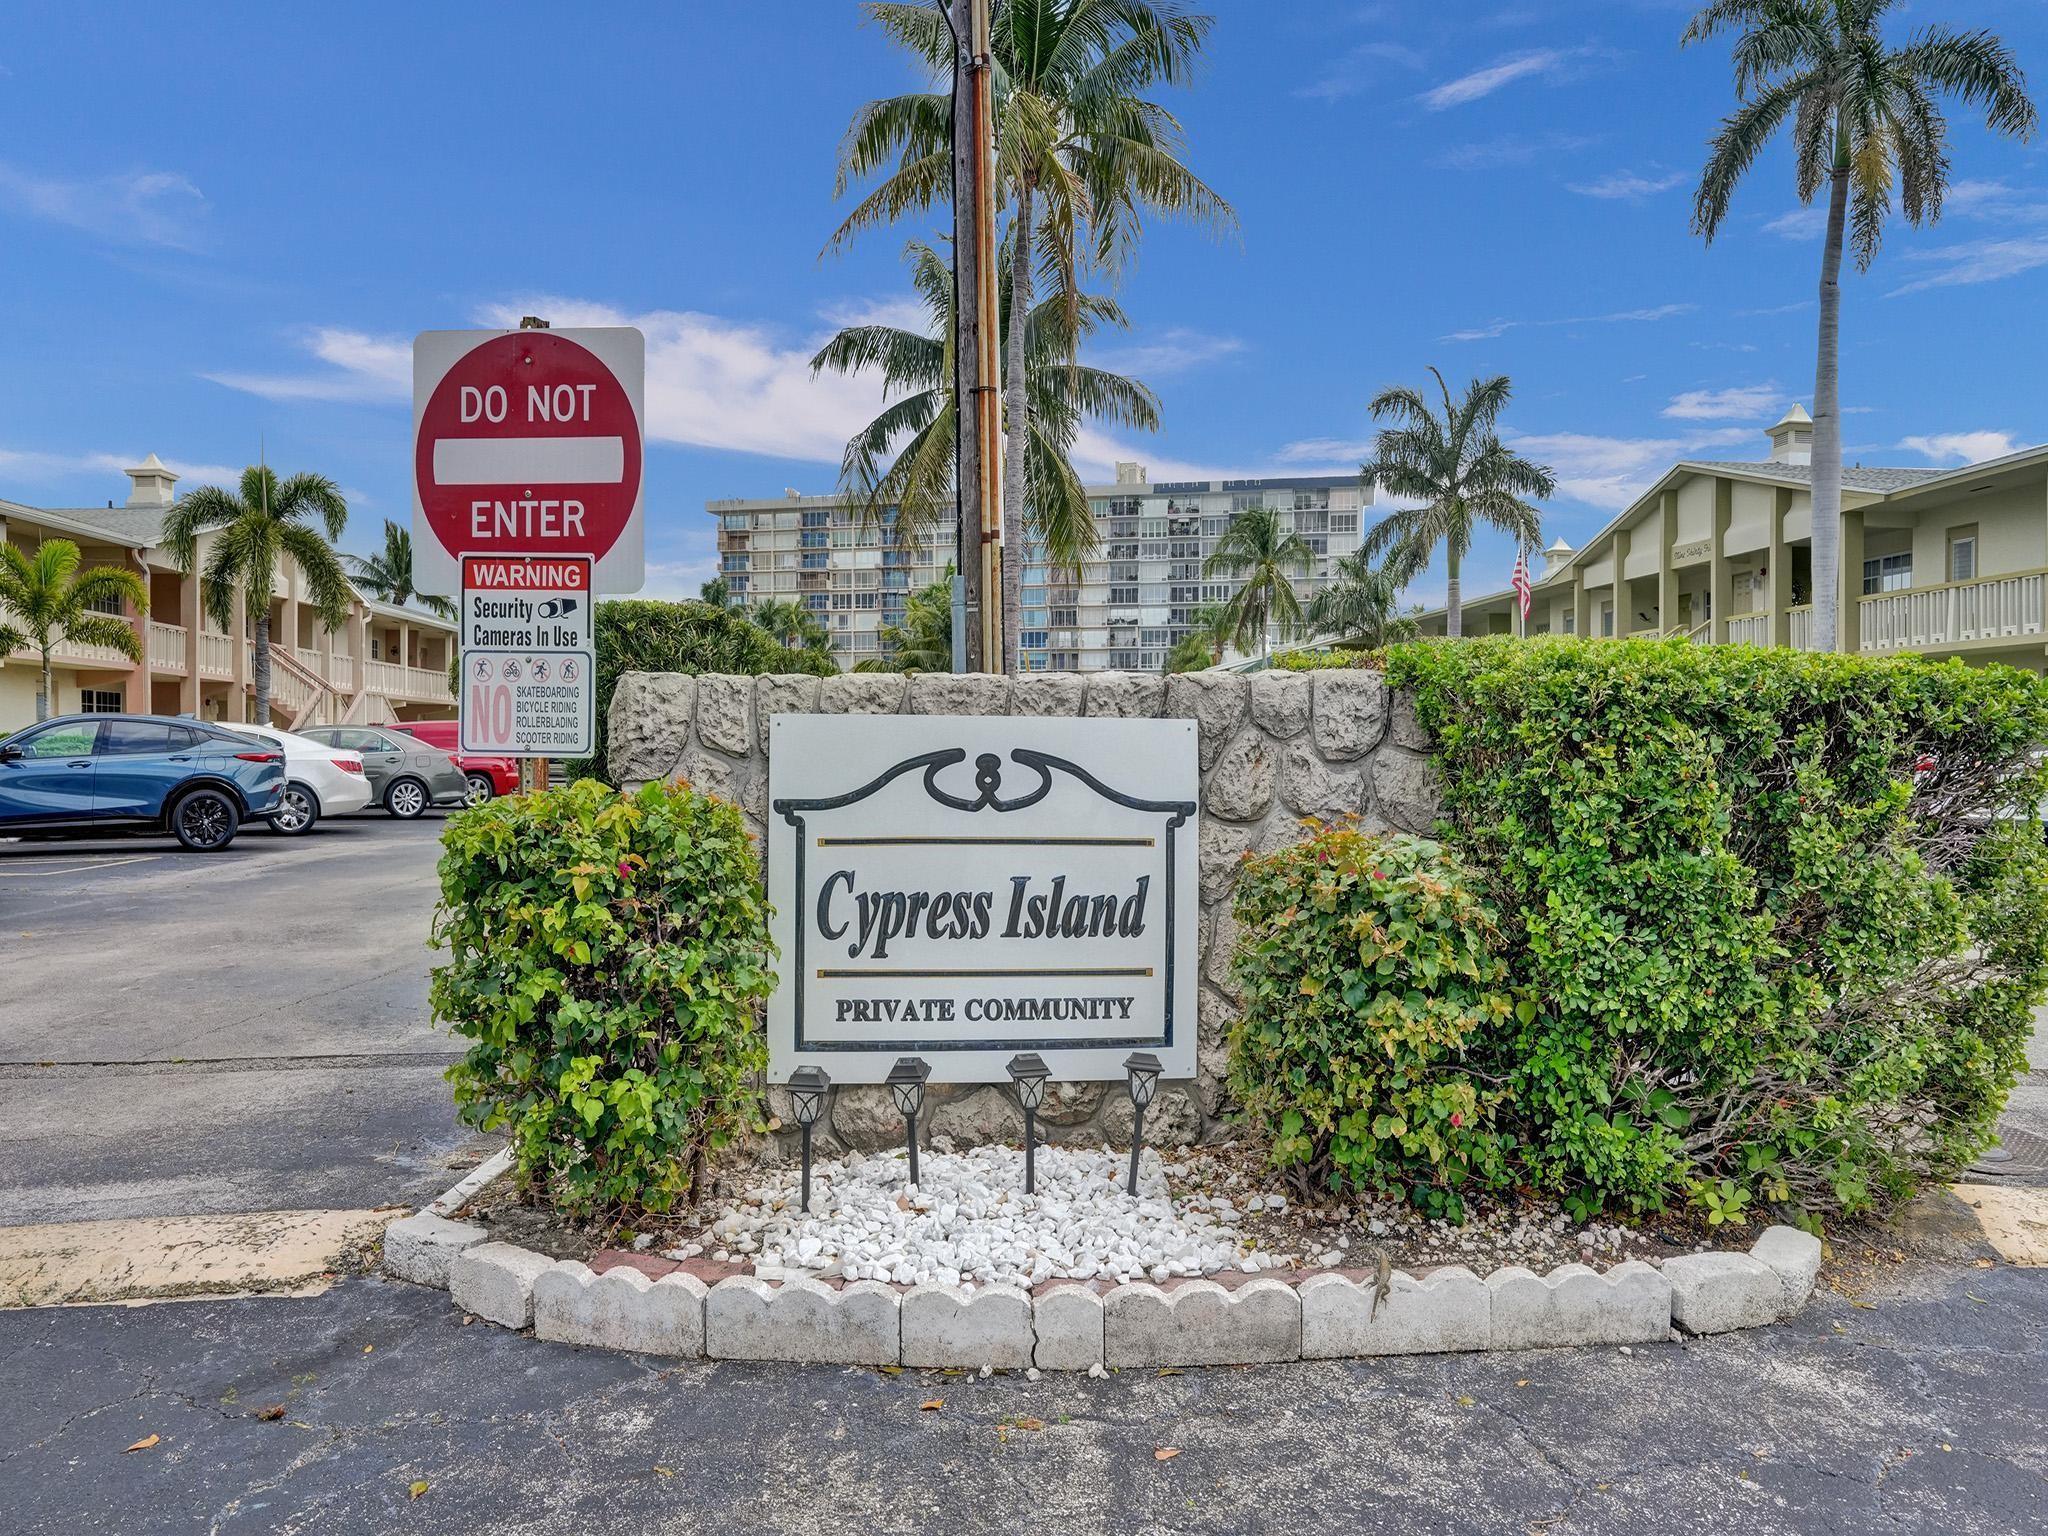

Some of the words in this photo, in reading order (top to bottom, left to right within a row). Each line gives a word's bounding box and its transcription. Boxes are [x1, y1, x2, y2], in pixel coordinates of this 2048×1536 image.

[460, 385, 508, 423] DO
[527, 384, 597, 423] NOT
[471, 500, 585, 538] ENTER
[473, 564, 581, 587] WARNING
[474, 596, 533, 623] Security
[474, 624, 532, 647] Cameras
[537, 625, 549, 647] In
[553, 625, 578, 647] Use
[516, 686, 580, 698] SKATEBOARDING
[471, 684, 512, 744] NO
[516, 701, 549, 713] BICYCLE
[550, 702, 577, 714] RIDING
[516, 716, 579, 728] ROLLERBLADING
[516, 732, 552, 744] SCOOTER
[553, 732, 579, 744] RIDING
[816, 870, 993, 959] Cypress
[1000, 874, 1151, 940] Island
[835, 999, 956, 1022] PRIVATE
[964, 997, 1135, 1021] COMMUNITY
